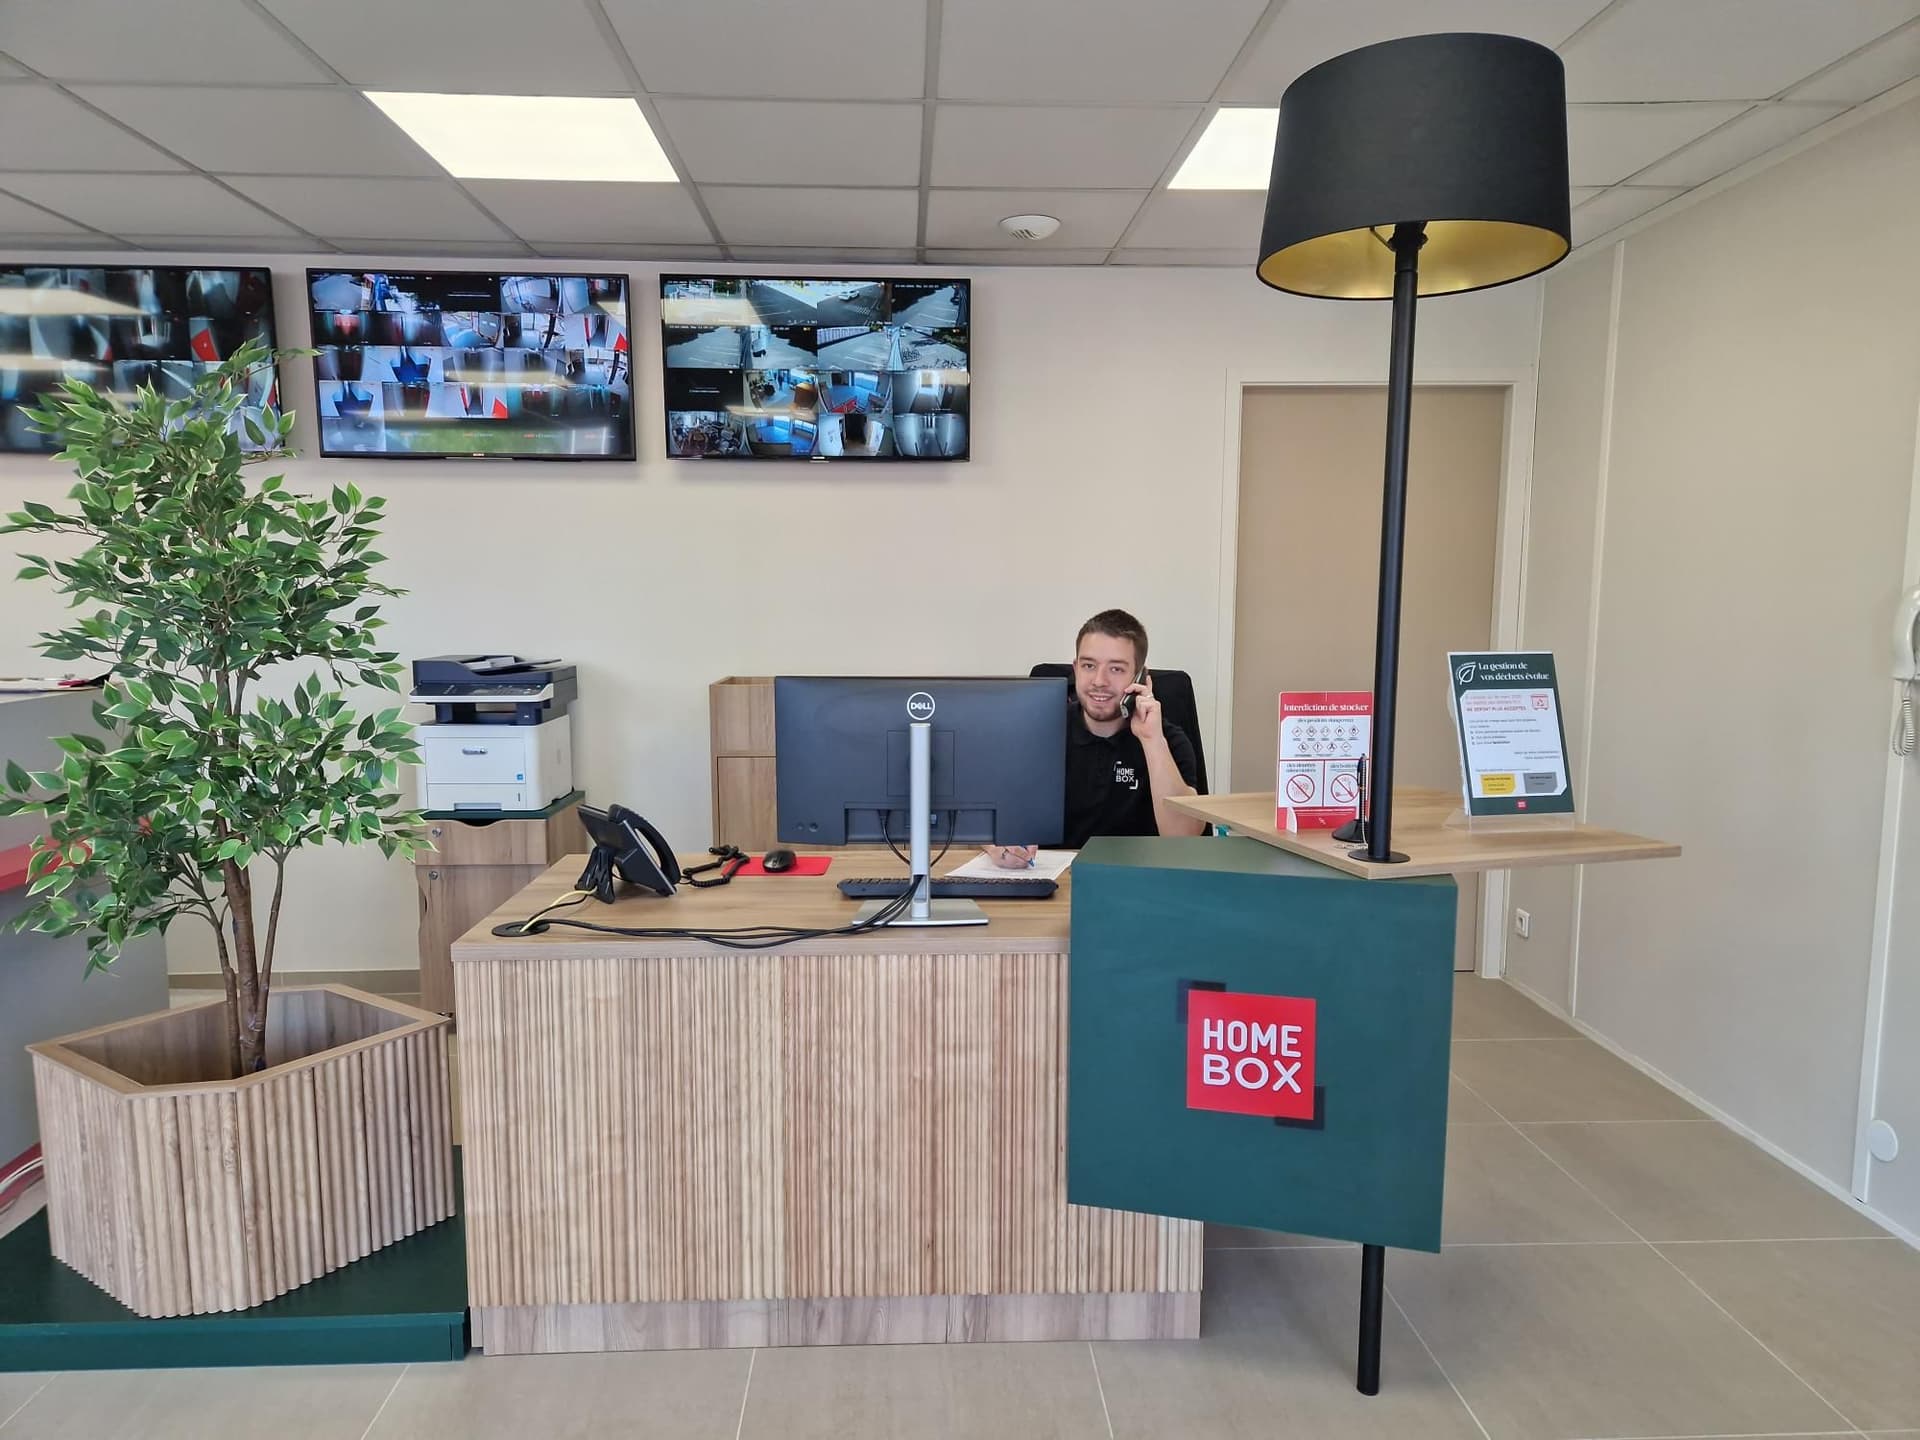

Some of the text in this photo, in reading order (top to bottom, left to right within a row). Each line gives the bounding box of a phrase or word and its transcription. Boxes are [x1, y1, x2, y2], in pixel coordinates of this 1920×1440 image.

[1478, 661, 1528, 671] La gestion de
[1495, 672, 1525, 680] déchets
[1525, 672, 1550, 680] évolue
[910, 702, 932, 710] DELL
[1284, 703, 1369, 711] Interdiction de stocker
[1116, 768, 1135, 776] HOME
[1115, 775, 1135, 783] BOX
[1203, 1018, 1302, 1058] HOME
[1203, 1053, 1302, 1094] BOX
